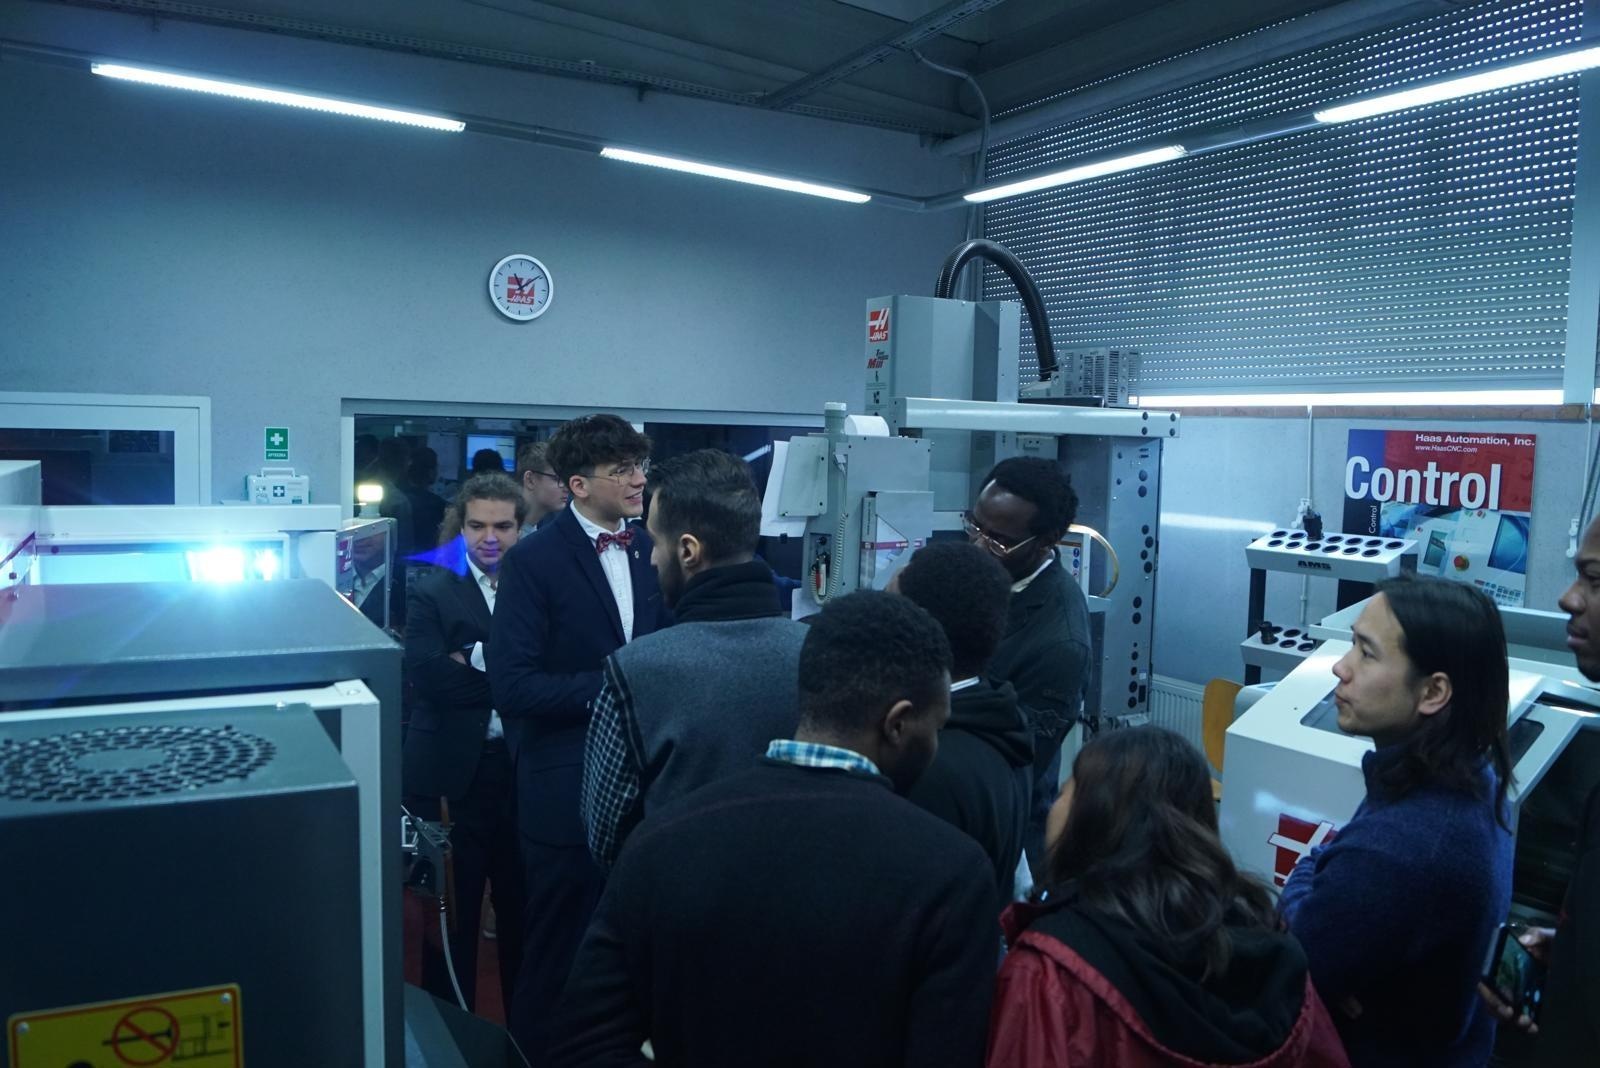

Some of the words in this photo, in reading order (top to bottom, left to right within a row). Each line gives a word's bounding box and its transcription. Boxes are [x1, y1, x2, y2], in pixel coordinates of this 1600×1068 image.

[1415, 433, 1442, 443] Haas
[1444, 434, 1511, 447] Automation,
[1514, 436, 1536, 447] Inc.
[1415, 444, 1478, 453] www.HaasCNC.com
[1344, 455, 1502, 511] Control
[1368, 505, 1378, 534] Control
